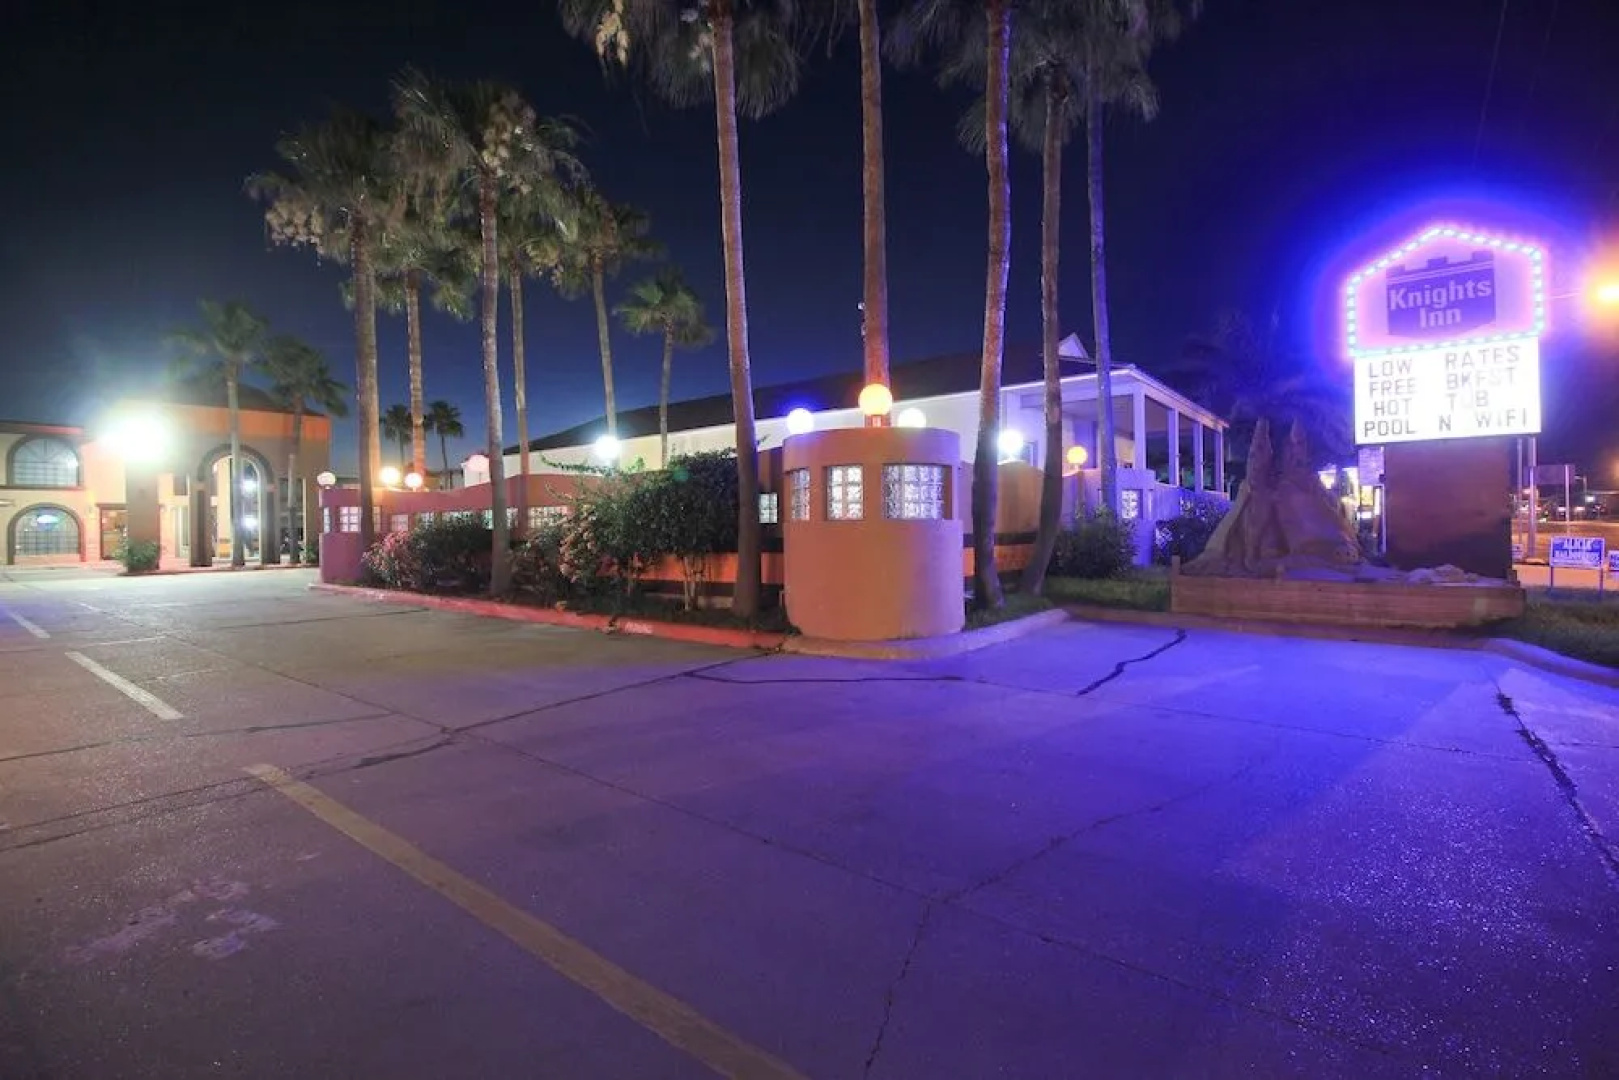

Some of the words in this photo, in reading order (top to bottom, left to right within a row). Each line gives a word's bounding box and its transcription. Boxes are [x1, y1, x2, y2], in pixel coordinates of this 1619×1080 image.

[1389, 280, 1491, 311] Knights
[1420, 308, 1461, 329] Inn
[1368, 358, 1412, 378] LOW
[1445, 345, 1520, 369] RATES
[1369, 377, 1416, 398] FREE
[1446, 367, 1515, 390] BKFST
[1374, 398, 1412, 417] HOT
[1446, 390, 1489, 411] TUB
[1364, 418, 1417, 438] POOL
[1438, 415, 1451, 432] N
